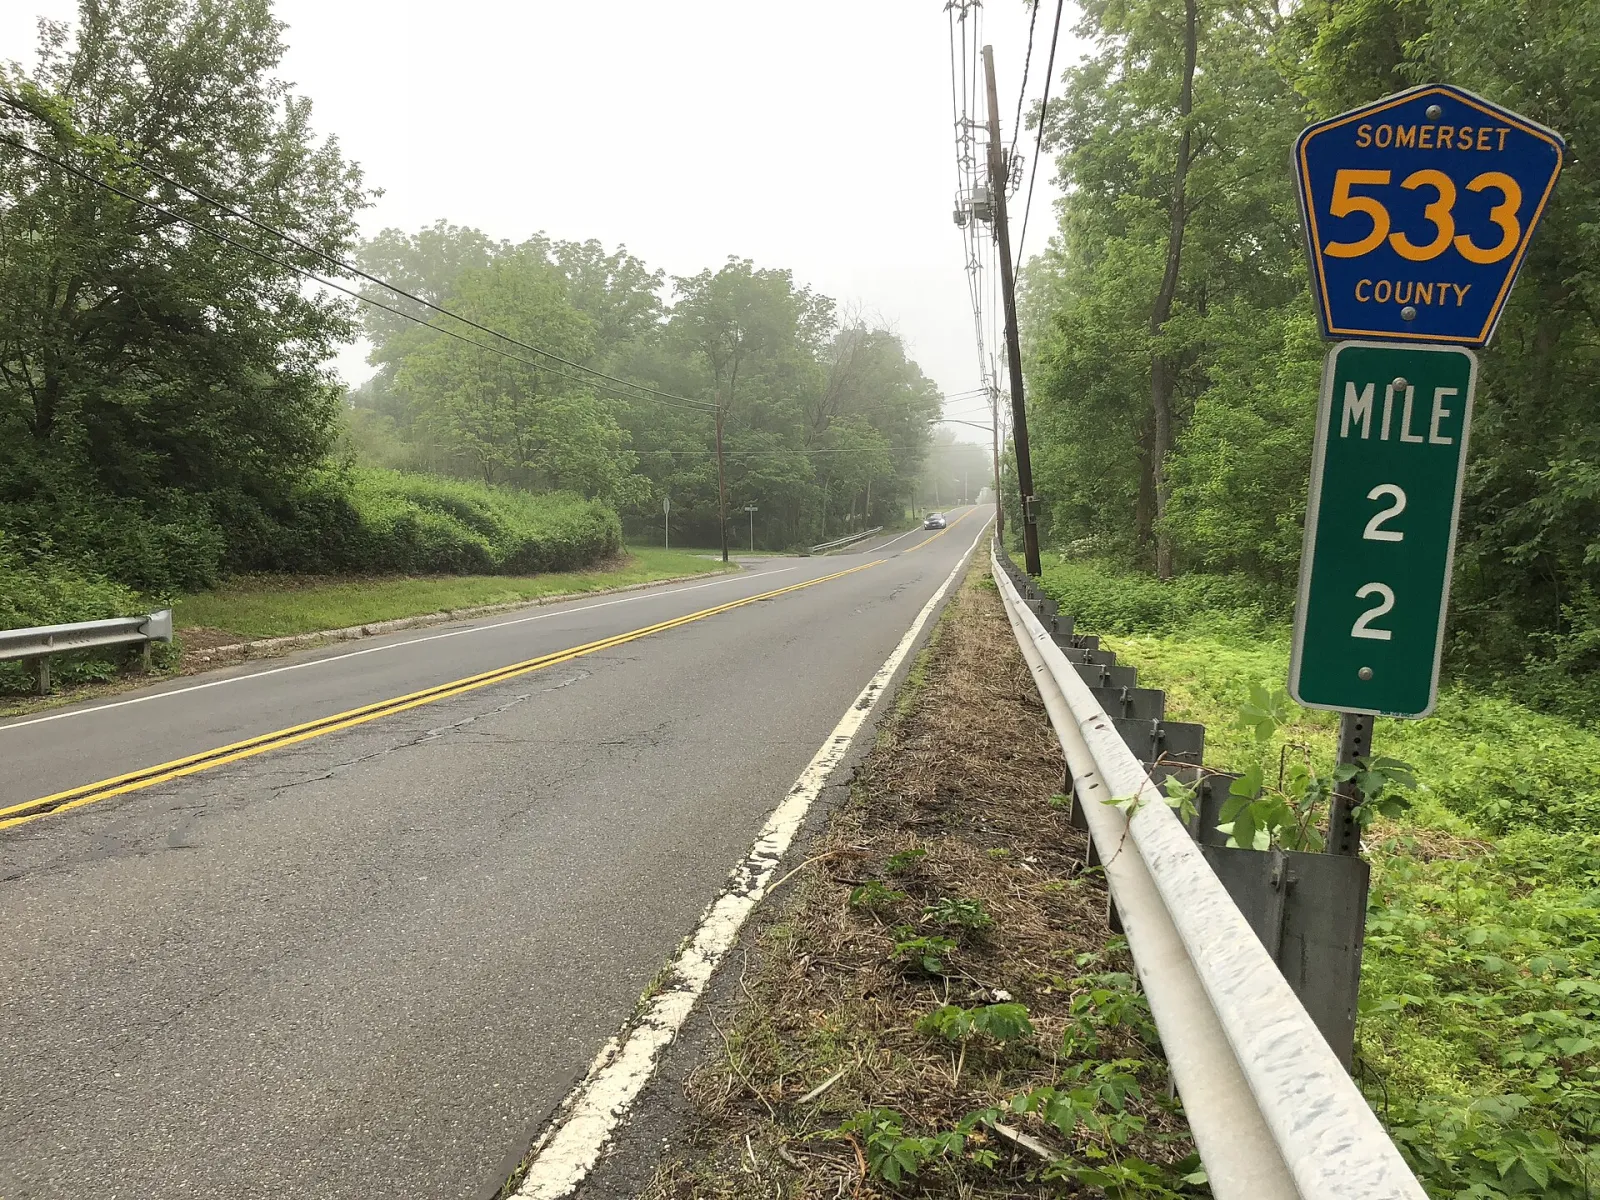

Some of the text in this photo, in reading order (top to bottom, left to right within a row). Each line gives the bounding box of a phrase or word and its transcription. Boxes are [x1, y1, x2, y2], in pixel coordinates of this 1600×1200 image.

[1355, 124, 1511, 151] SOMERSET
[1323, 169, 1522, 264] 533
[1355, 279, 1471, 307] COUNTY
[1340, 382, 1459, 445] MILE
[1363, 483, 1407, 542] 2
[1351, 582, 1395, 641] 2
